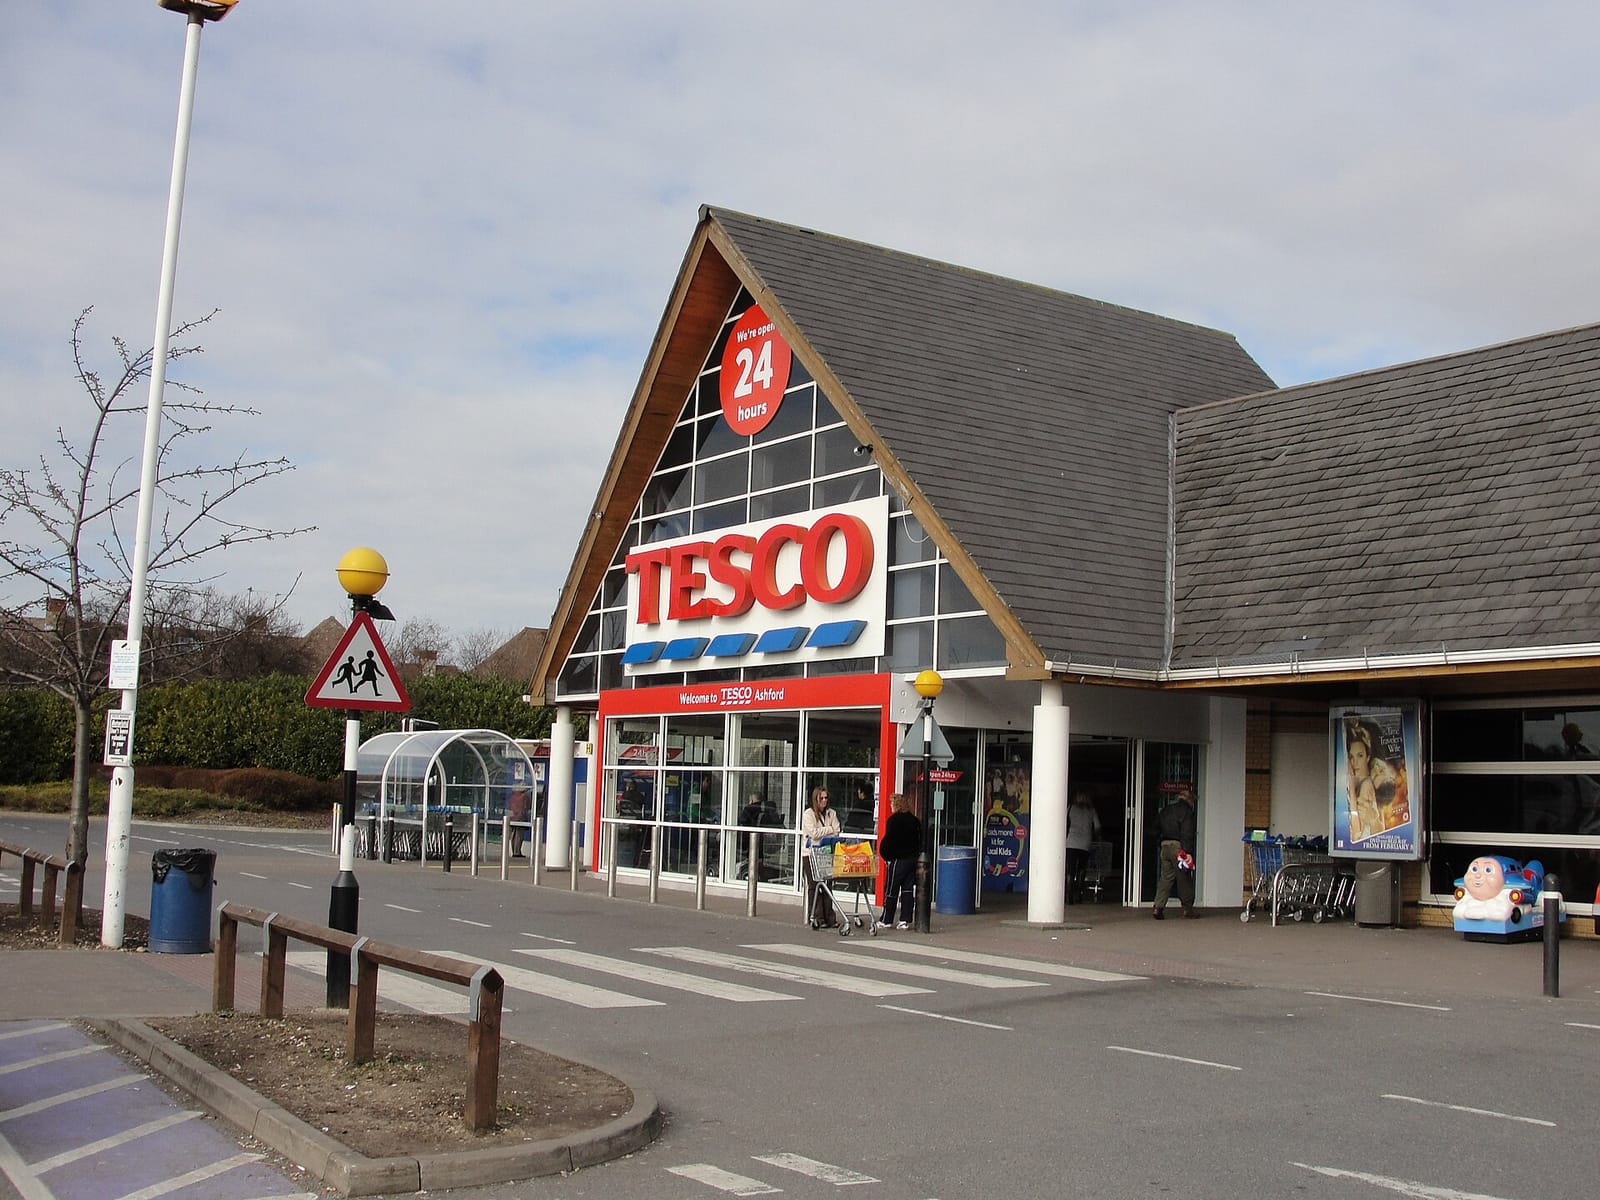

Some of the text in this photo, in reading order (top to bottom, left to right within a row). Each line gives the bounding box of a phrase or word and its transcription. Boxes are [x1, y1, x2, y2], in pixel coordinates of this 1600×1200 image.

[737, 329, 756, 343] We're
[734, 340, 774, 399] 24
[737, 402, 767, 422] hours
[625, 513, 875, 625] TESCO
[680, 687, 784, 705] Welcome to TESCO Ashford
